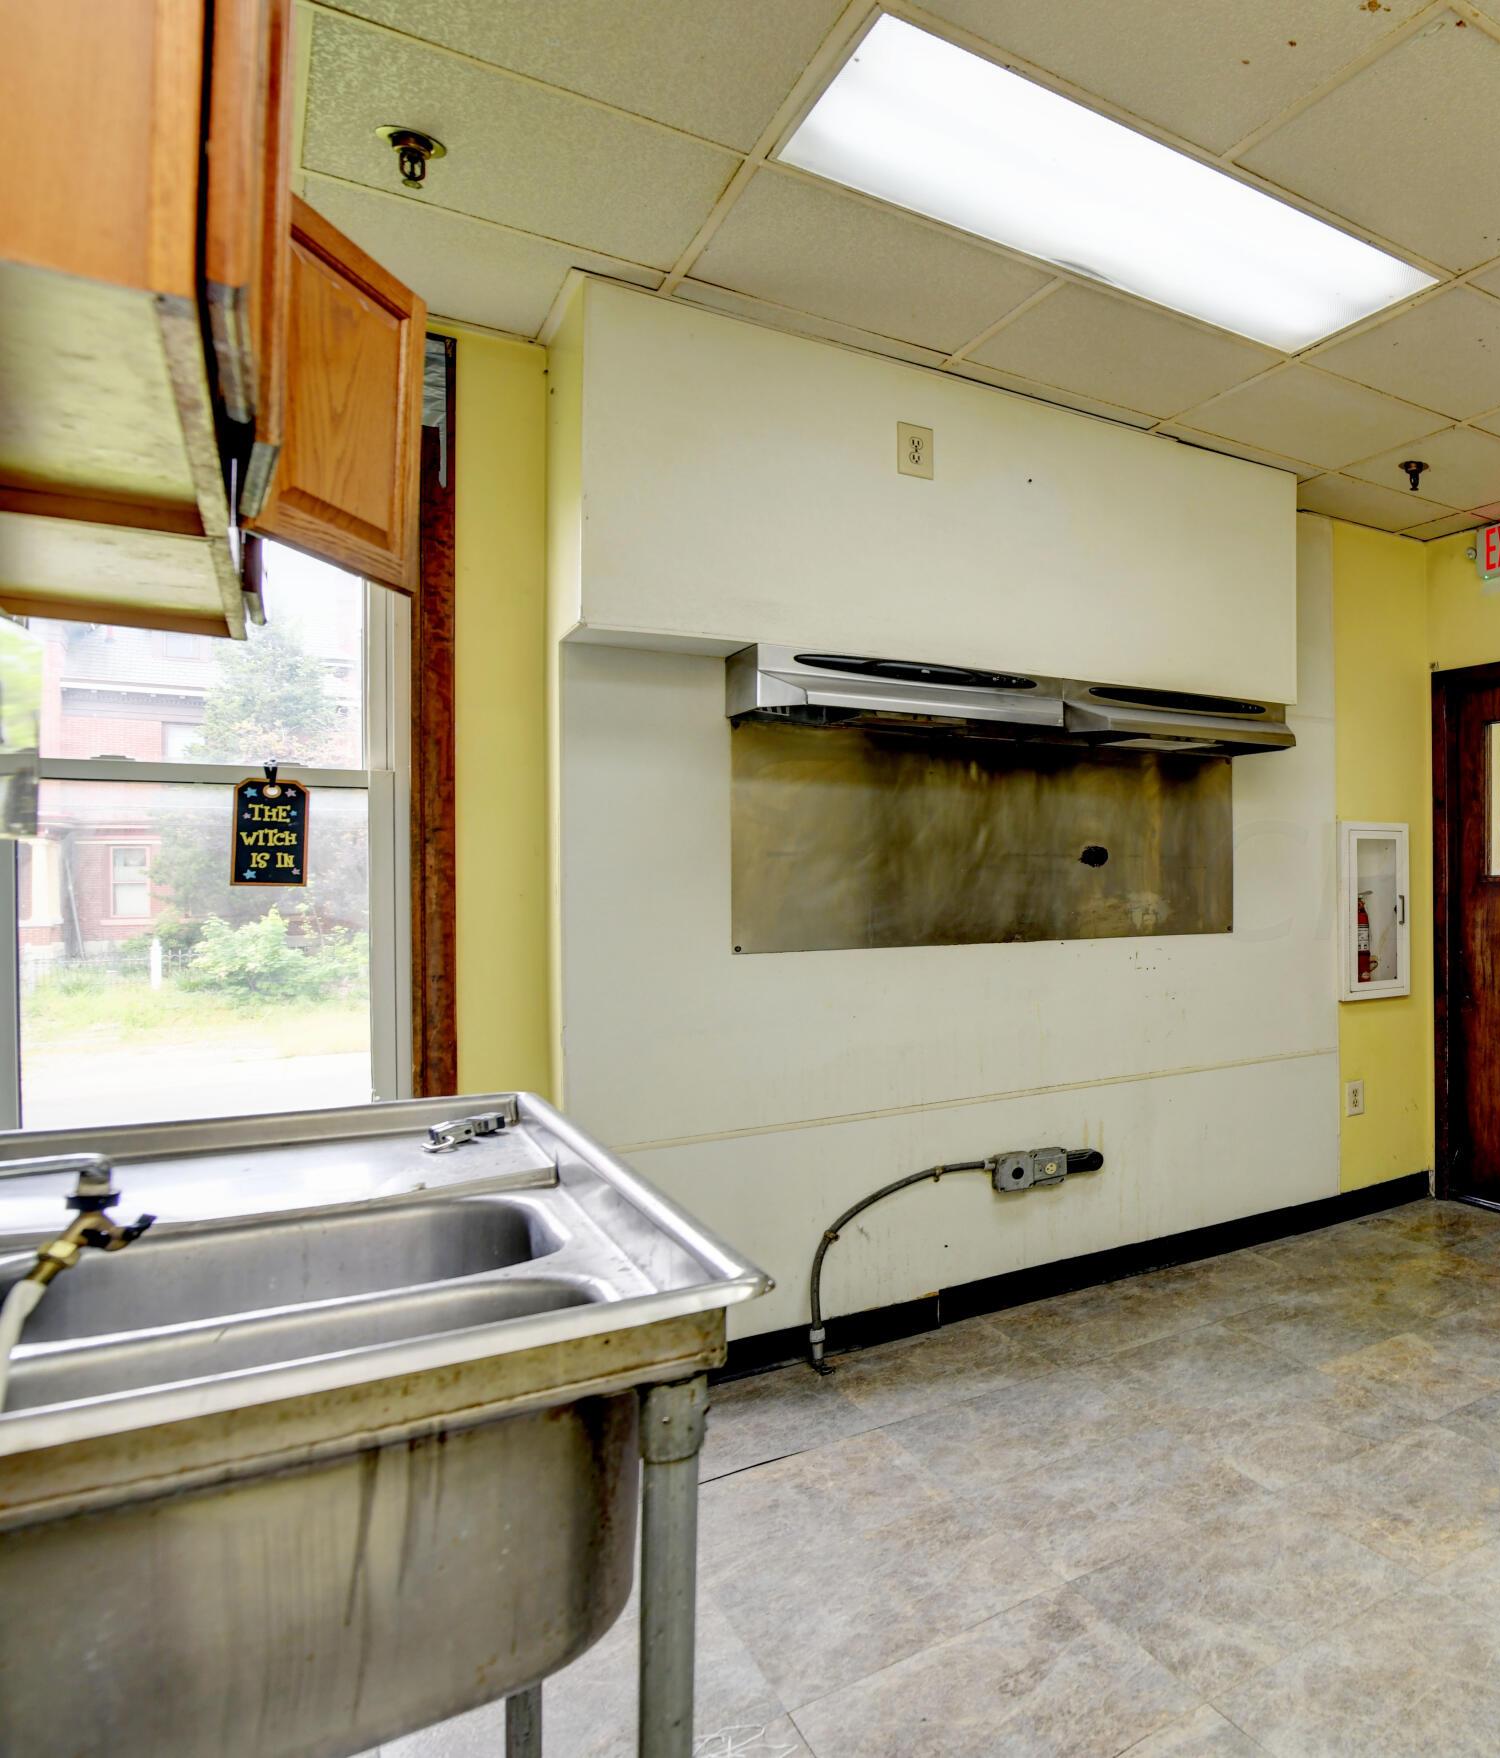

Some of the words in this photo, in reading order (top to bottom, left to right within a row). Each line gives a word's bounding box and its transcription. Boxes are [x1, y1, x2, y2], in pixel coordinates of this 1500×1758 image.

[249, 803, 291, 823] THE
[240, 828, 297, 846] WITCH
[250, 852, 270, 869] IS
[275, 852, 295, 868] IN
